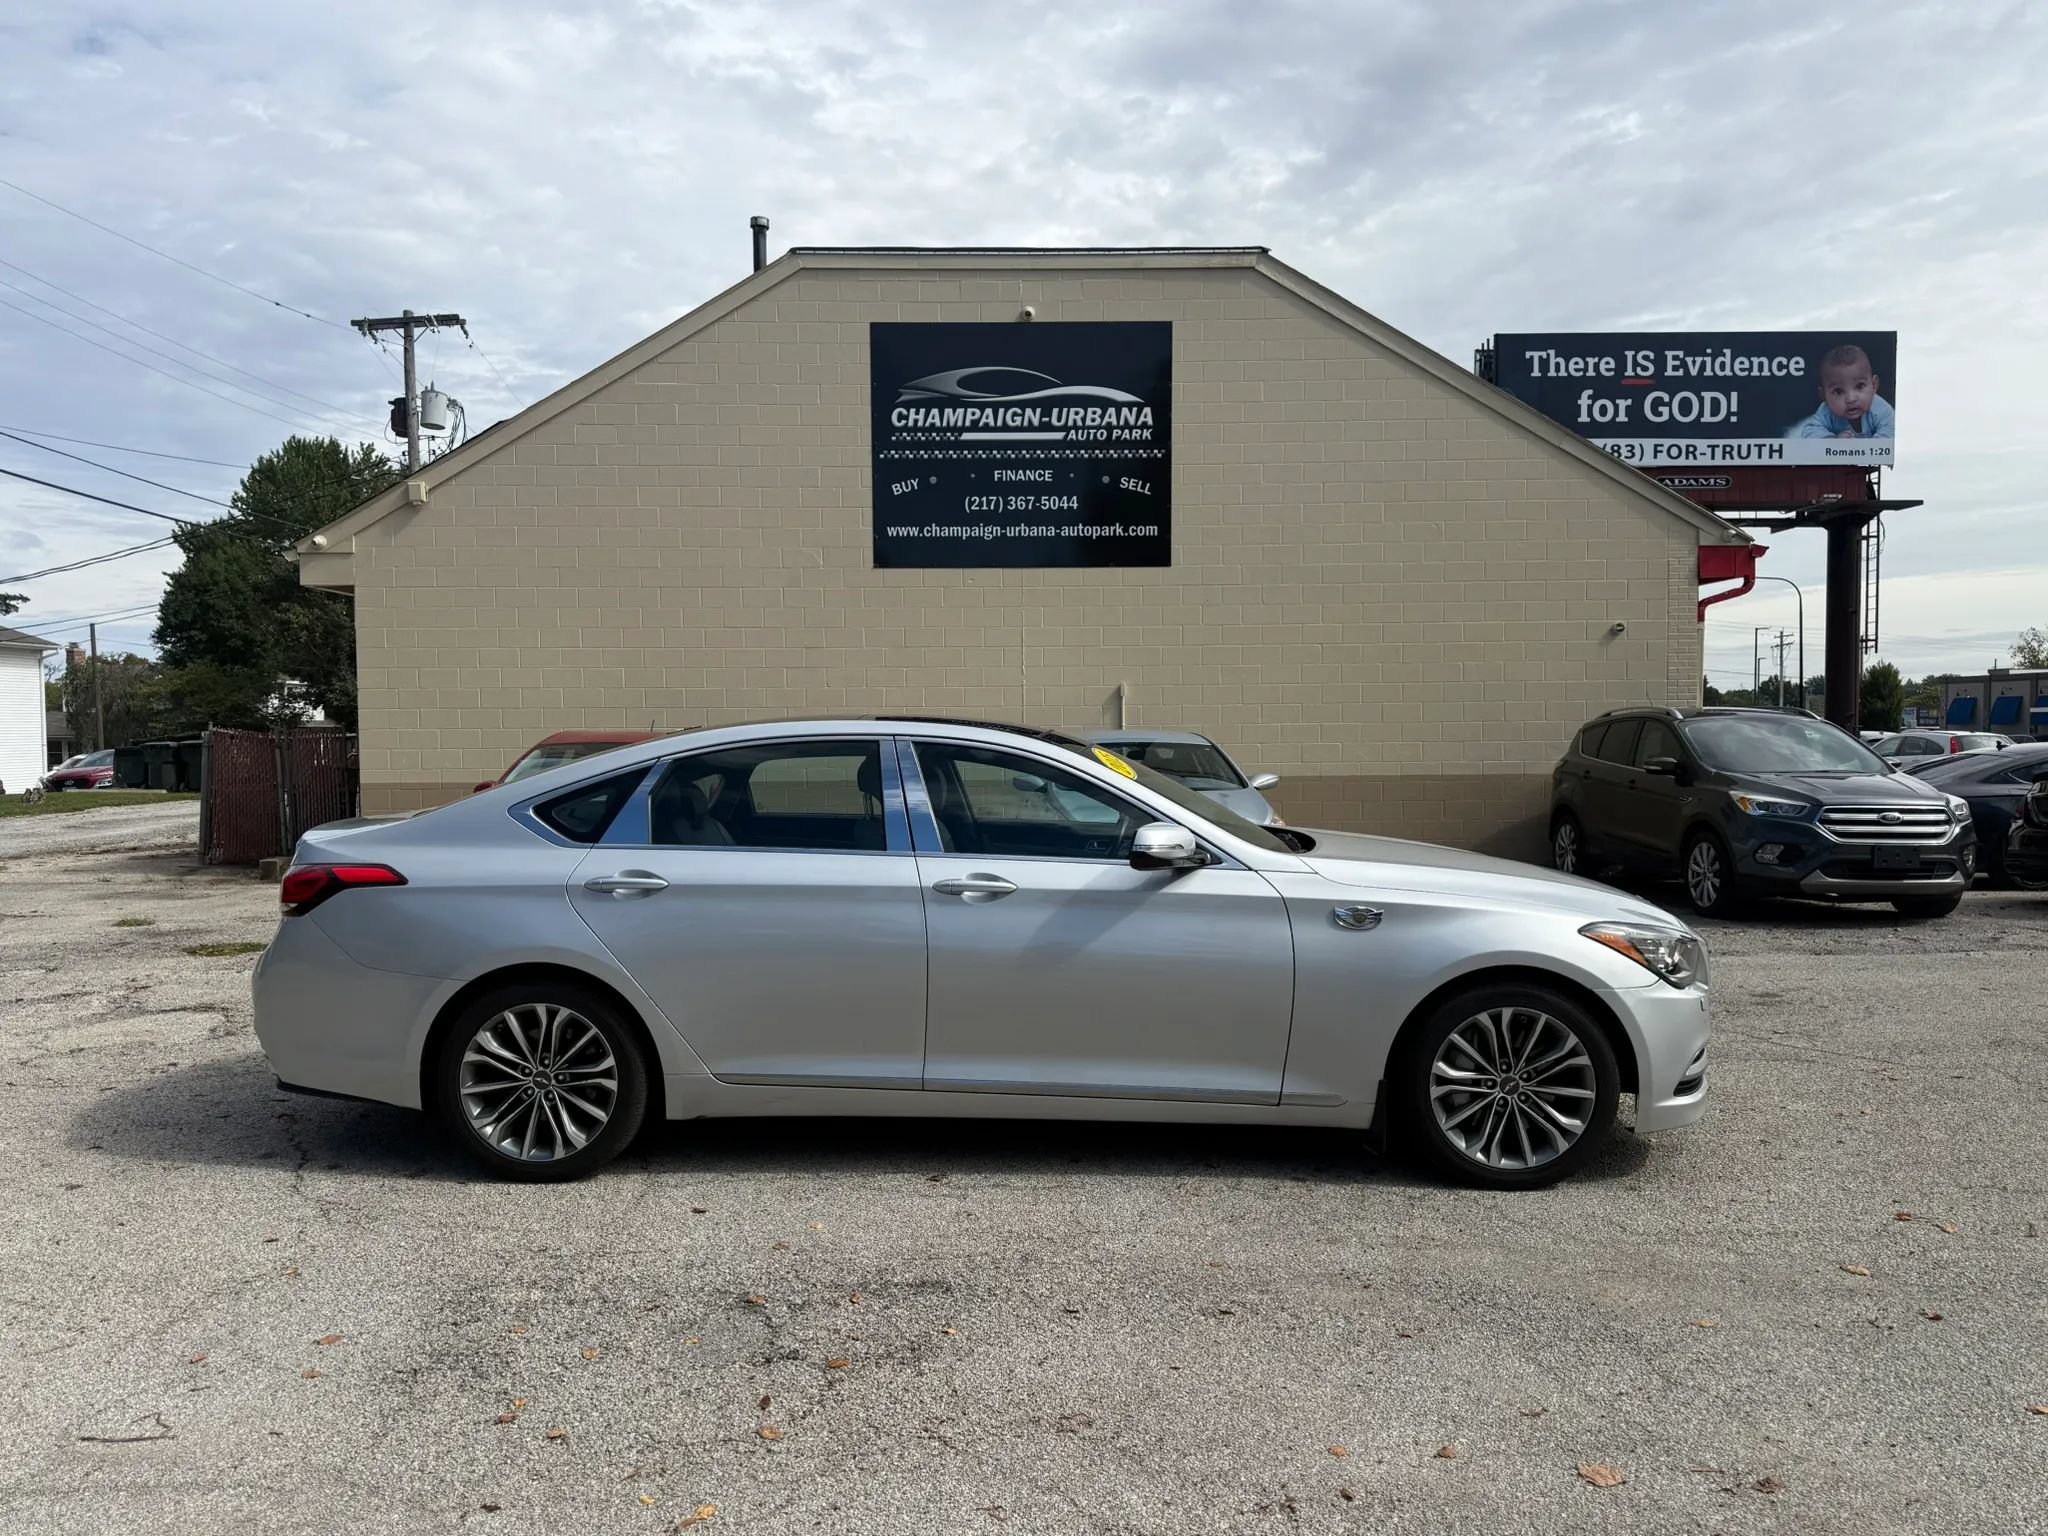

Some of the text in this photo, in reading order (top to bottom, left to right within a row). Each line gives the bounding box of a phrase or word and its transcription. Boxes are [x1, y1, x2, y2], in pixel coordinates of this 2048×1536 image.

[1525, 348, 1805, 377] There IS Evidence
[1577, 389, 1738, 423] for GOD!
[891, 406, 1153, 427] CHAMPAIGN-URBANA
[1067, 428, 1153, 441] AUTO PARK
[1653, 443, 1784, 461] FOR-TRUTH
[1825, 446, 1892, 457] Romans 1:20
[994, 469, 1053, 482] FINANCE
[1662, 478, 1727, 487] ADAMS
[891, 478, 919, 496] BUY
[1119, 476, 1152, 495] SELL
[964, 495, 1079, 513] (217) 367-5044
[886, 522, 1159, 541] www.champaign-urbana-autopark.com
